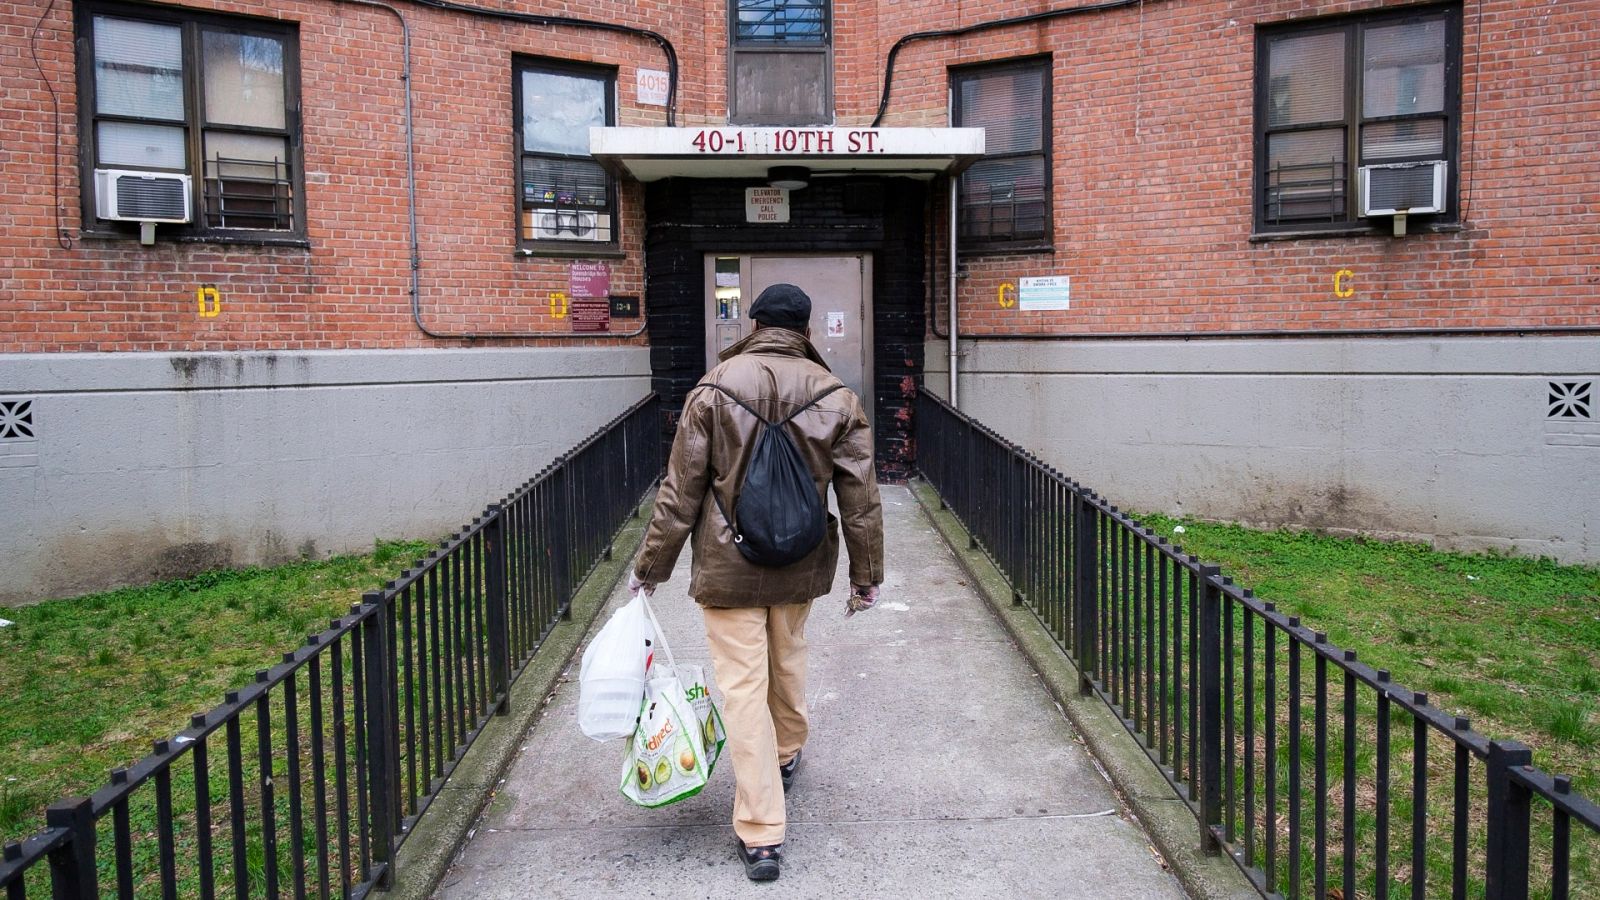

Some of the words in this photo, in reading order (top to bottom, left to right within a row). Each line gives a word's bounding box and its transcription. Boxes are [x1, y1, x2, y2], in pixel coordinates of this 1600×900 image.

[774, 129, 834, 153] 10TH
[847, 131, 885, 153] ST.
[751, 196, 784, 205] EMERGENCY
[753, 189, 782, 197] ELEVATOR
[757, 213, 777, 221] POLICE
[571, 263, 597, 271] WELCOME
[998, 282, 1015, 309] C
[1334, 269, 1354, 298] C
[197, 286, 221, 318] D
[549, 292, 568, 319] D
